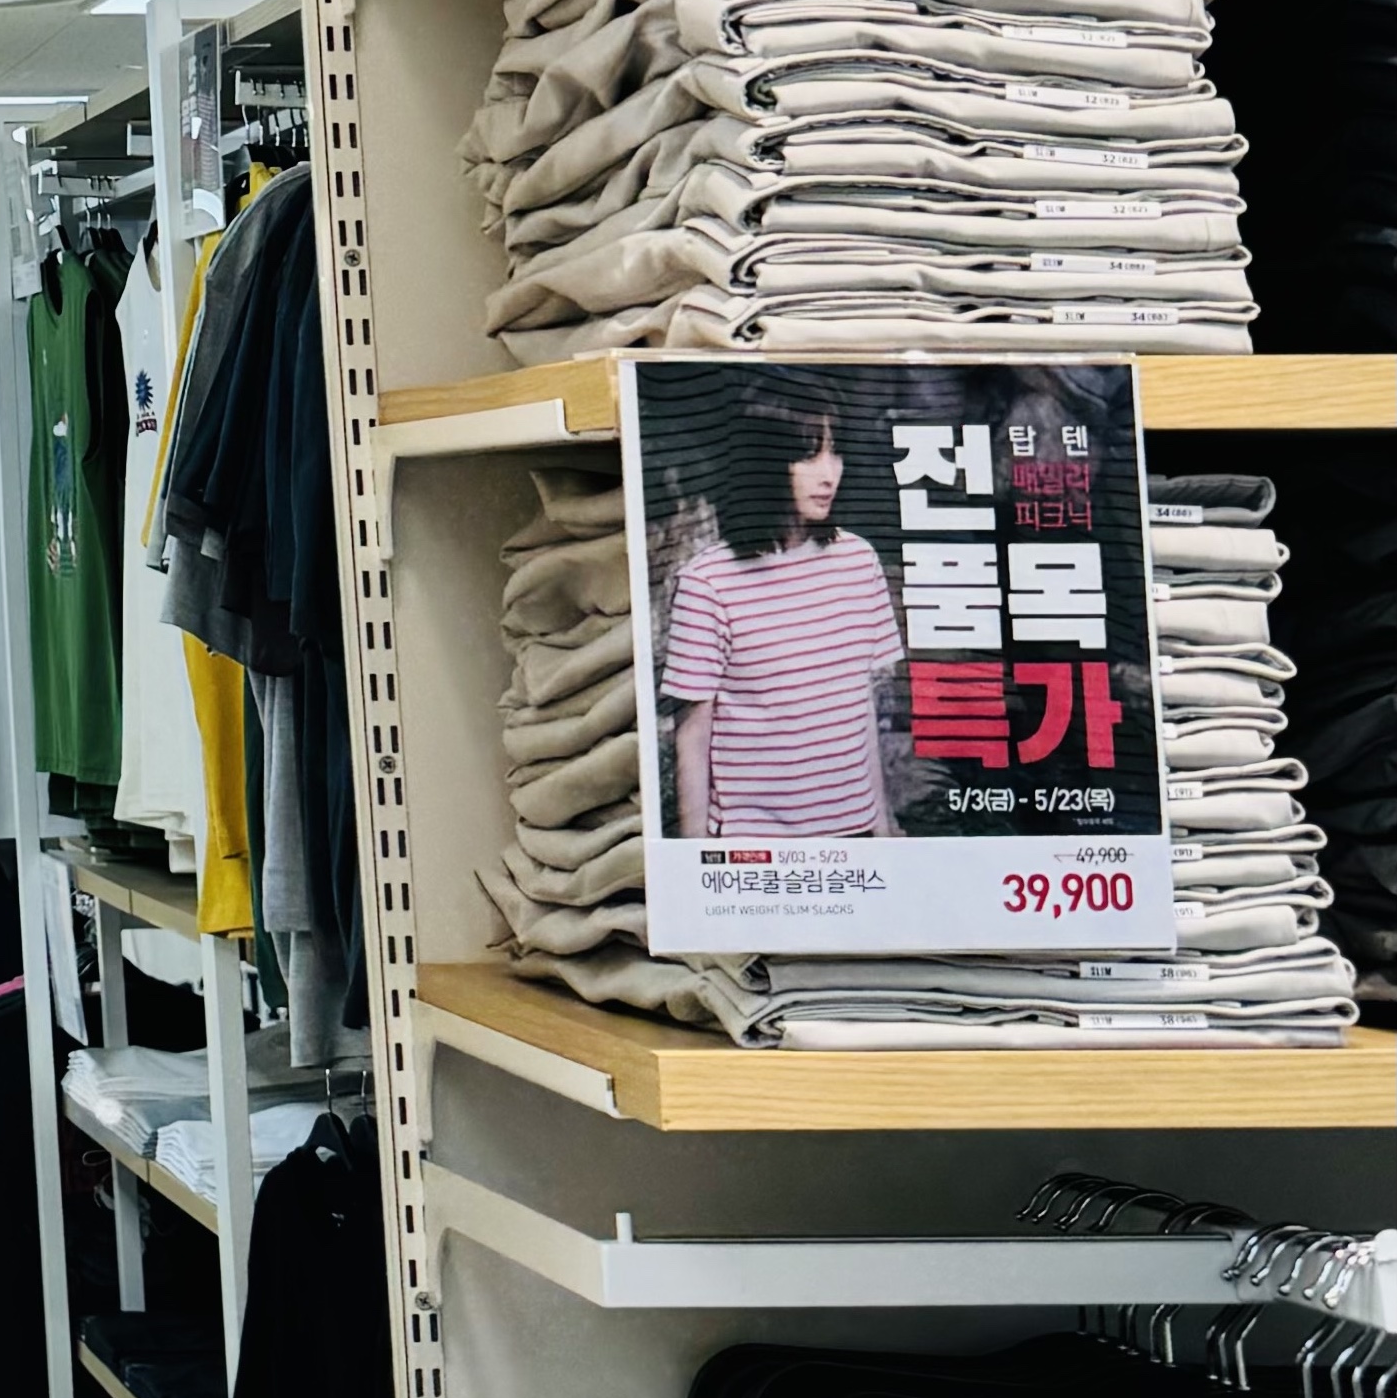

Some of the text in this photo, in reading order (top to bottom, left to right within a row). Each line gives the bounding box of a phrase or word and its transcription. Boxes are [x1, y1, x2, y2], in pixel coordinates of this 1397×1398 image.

[1014, 501, 1092, 532] 피크닉
[948, 787, 1015, 813] 5/3(금)
[1034, 787, 1115, 813] 5/23(목)
[778, 850, 806, 863] 5/03
[820, 850, 848, 863] 5/23
[1076, 847, 1127, 866] 49,900
[701, 869, 886, 894] 에어로쿨 슬림 슬랙스
[1002, 872, 1134, 920] 39,900
[705, 904, 854, 916] LIGHT WEIGHT SLIM SLACKS
